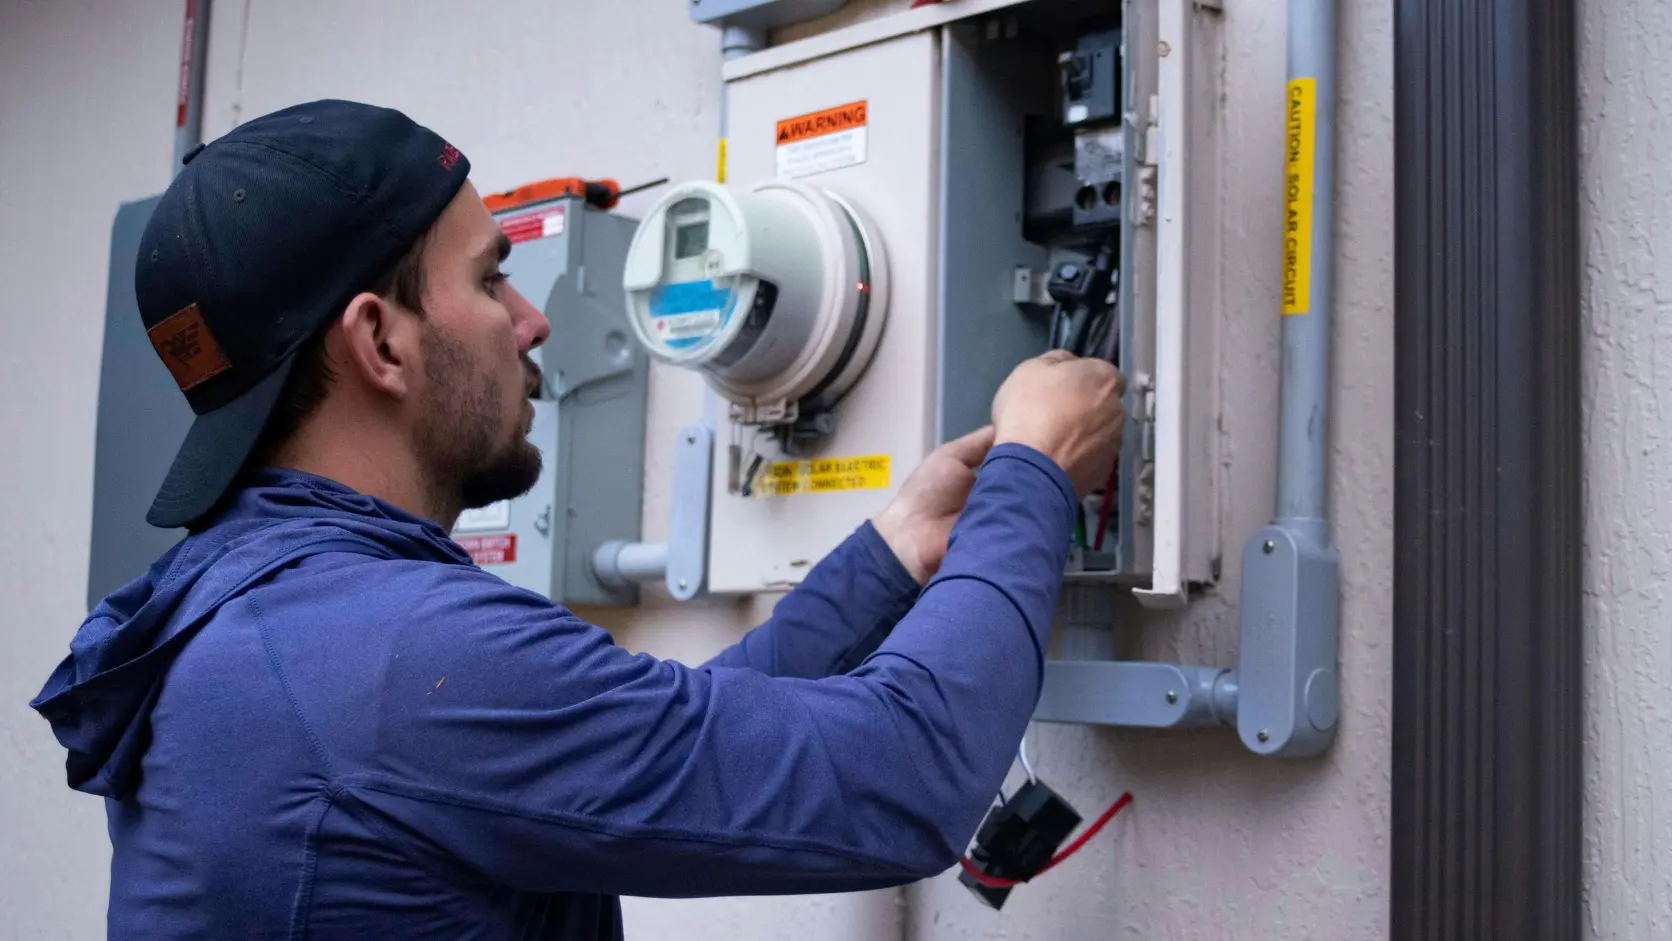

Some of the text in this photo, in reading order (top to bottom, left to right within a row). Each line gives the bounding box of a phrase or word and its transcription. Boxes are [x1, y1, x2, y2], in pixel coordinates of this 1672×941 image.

[791, 106, 866, 137] WARNING
[1286, 173, 1300, 234] SOLAR
[1282, 237, 1298, 307] CIRCUIT
[836, 459, 885, 473] ELECTRIC
